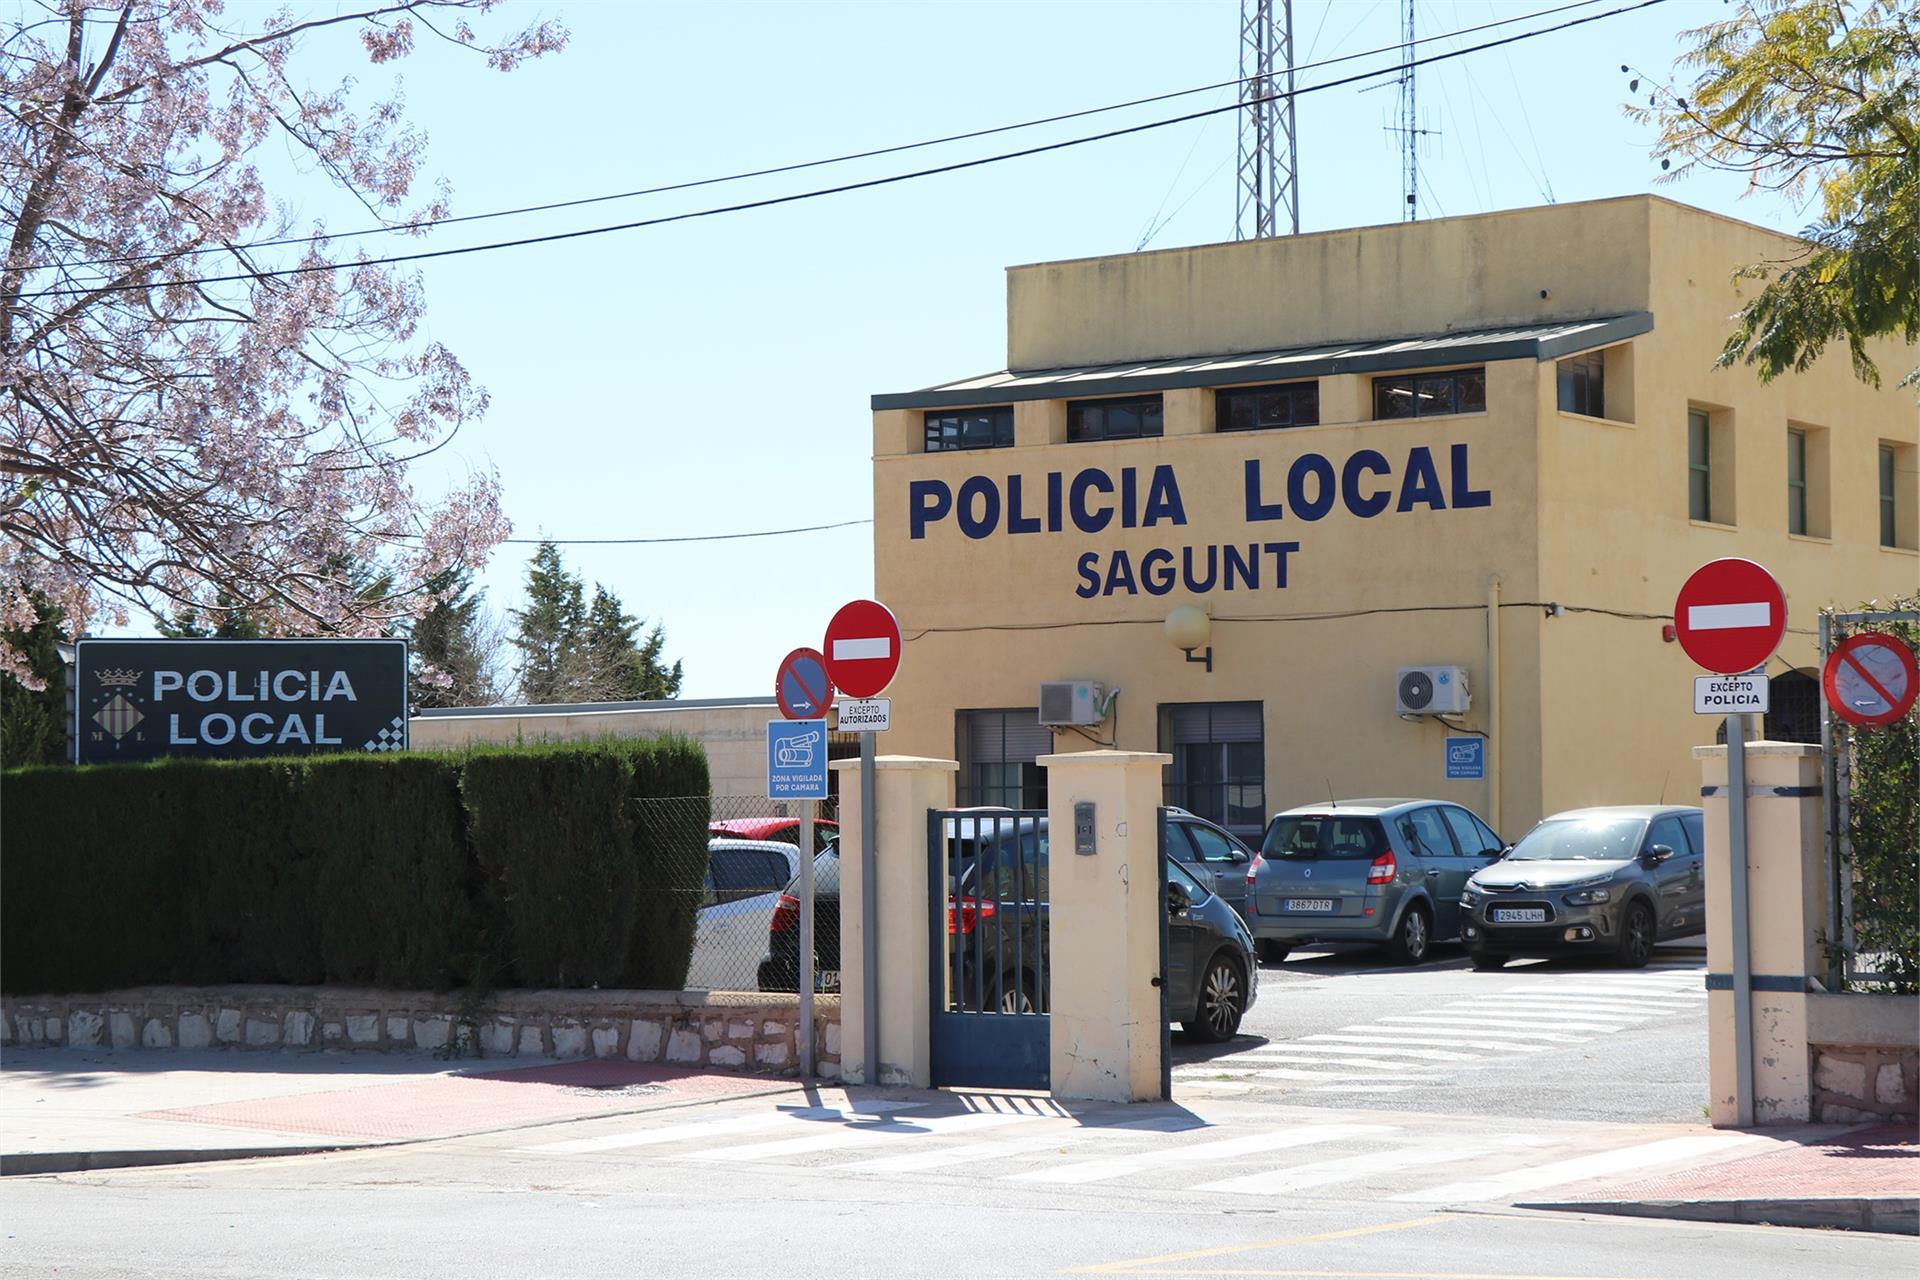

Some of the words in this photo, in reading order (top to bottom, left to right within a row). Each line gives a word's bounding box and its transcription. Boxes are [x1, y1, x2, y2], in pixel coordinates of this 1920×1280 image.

[910, 465, 1187, 539] POLICIA
[1245, 444, 1491, 521] LOCAL
[1075, 542, 1300, 598] SAGUNT
[153, 670, 358, 702] POLICIA
[1711, 682, 1752, 692] EXCEPTO
[1704, 695, 1760, 705] POLICIA
[848, 705, 880, 714] EXCEPTO
[840, 714, 887, 725] AUTORIZADOS
[170, 713, 342, 745] LOCAL
[772, 775, 791, 783] ZONA
[792, 774, 823, 783] VIGILADA
[775, 784, 789, 792] POR
[791, 784, 819, 792] CAMARA
